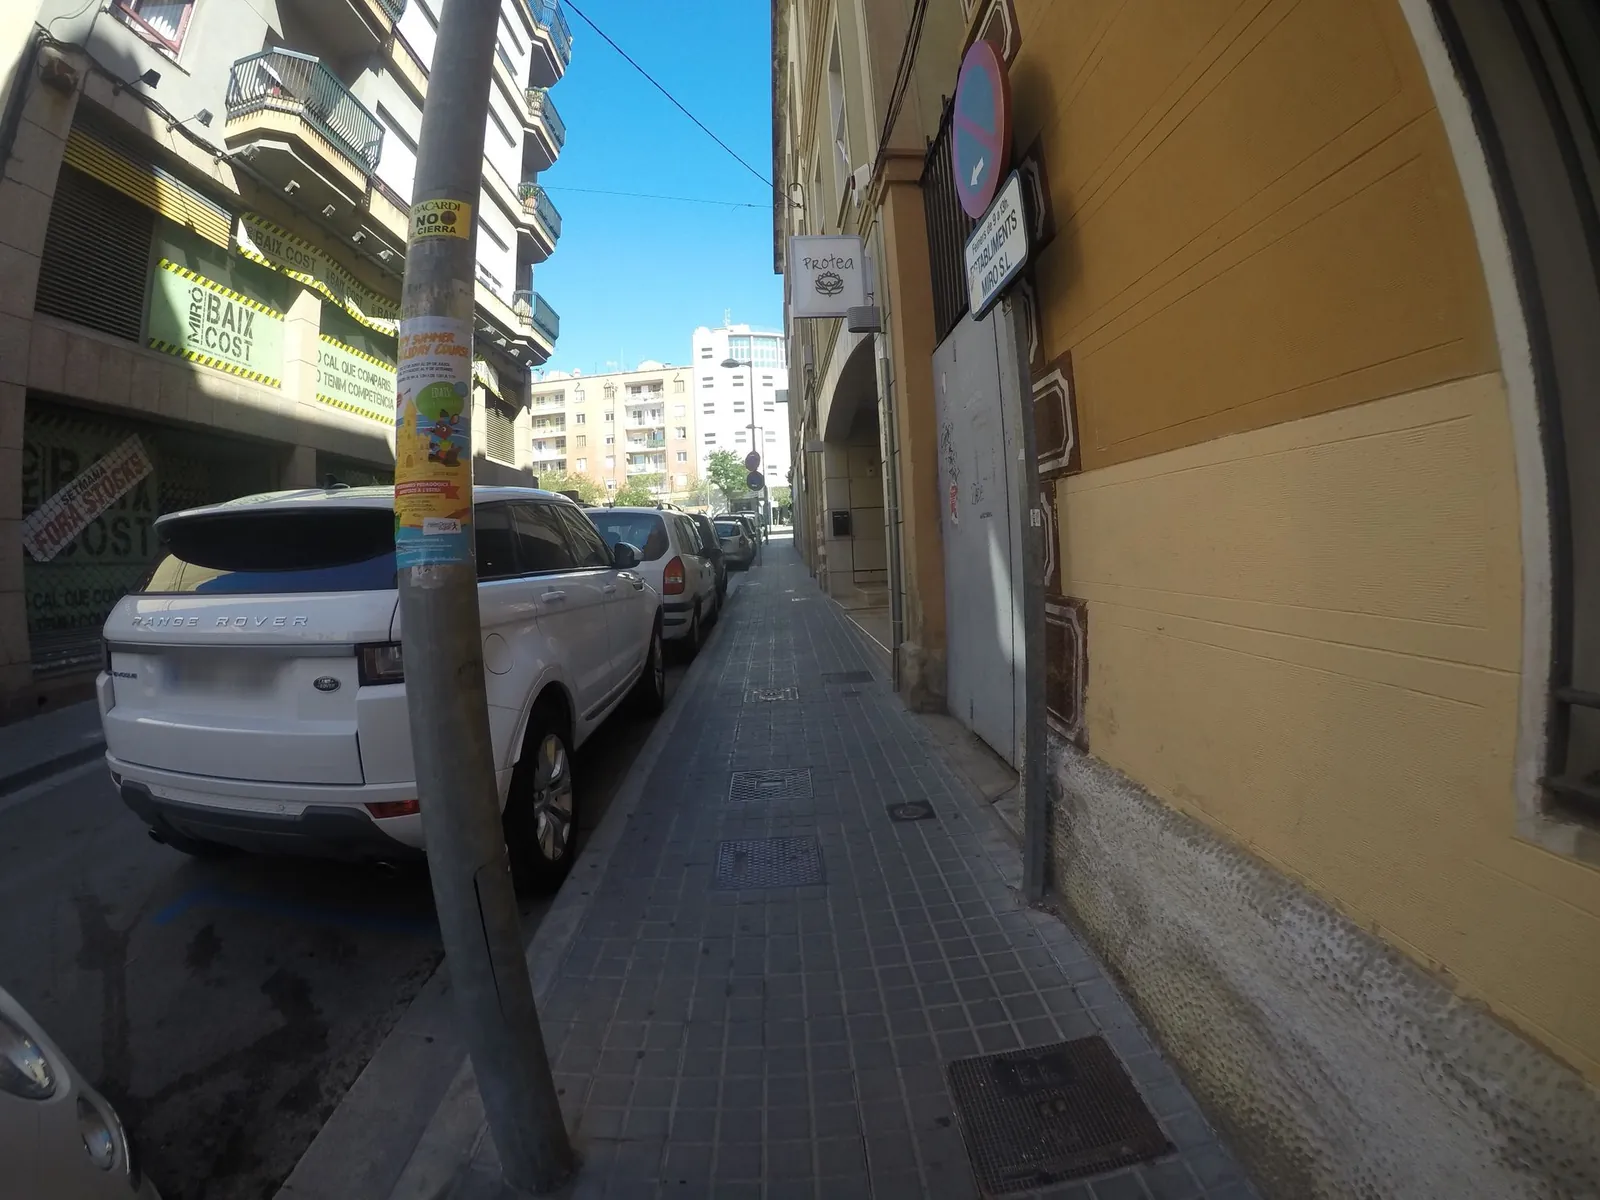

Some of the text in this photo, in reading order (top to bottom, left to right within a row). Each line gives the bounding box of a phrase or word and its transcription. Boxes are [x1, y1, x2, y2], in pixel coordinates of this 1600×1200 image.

[414, 201, 461, 215] BACARDI
[416, 213, 439, 228] NO
[417, 225, 457, 235] CIERRA
[986, 221, 993, 235] de
[992, 213, 997, 226] 9
[255, 231, 283, 257] BAIX
[285, 246, 317, 272] COST
[330, 271, 345, 293] BAIX
[981, 251, 1013, 298] MIRO S.L.
[187, 286, 204, 344] MIRÓ
[206, 292, 255, 340] BAIX
[205, 326, 253, 361] COST
[412, 331, 455, 345] SUMMER
[323, 353, 340, 371] CAL
[341, 360, 356, 378] QUE
[323, 371, 347, 392] TENIM
[61, 467, 107, 507] SETMANA
[33, 502, 84, 550] FORA
[81, 452, 145, 511] STOCKS
[132, 615, 309, 627] RANGE ROVER
